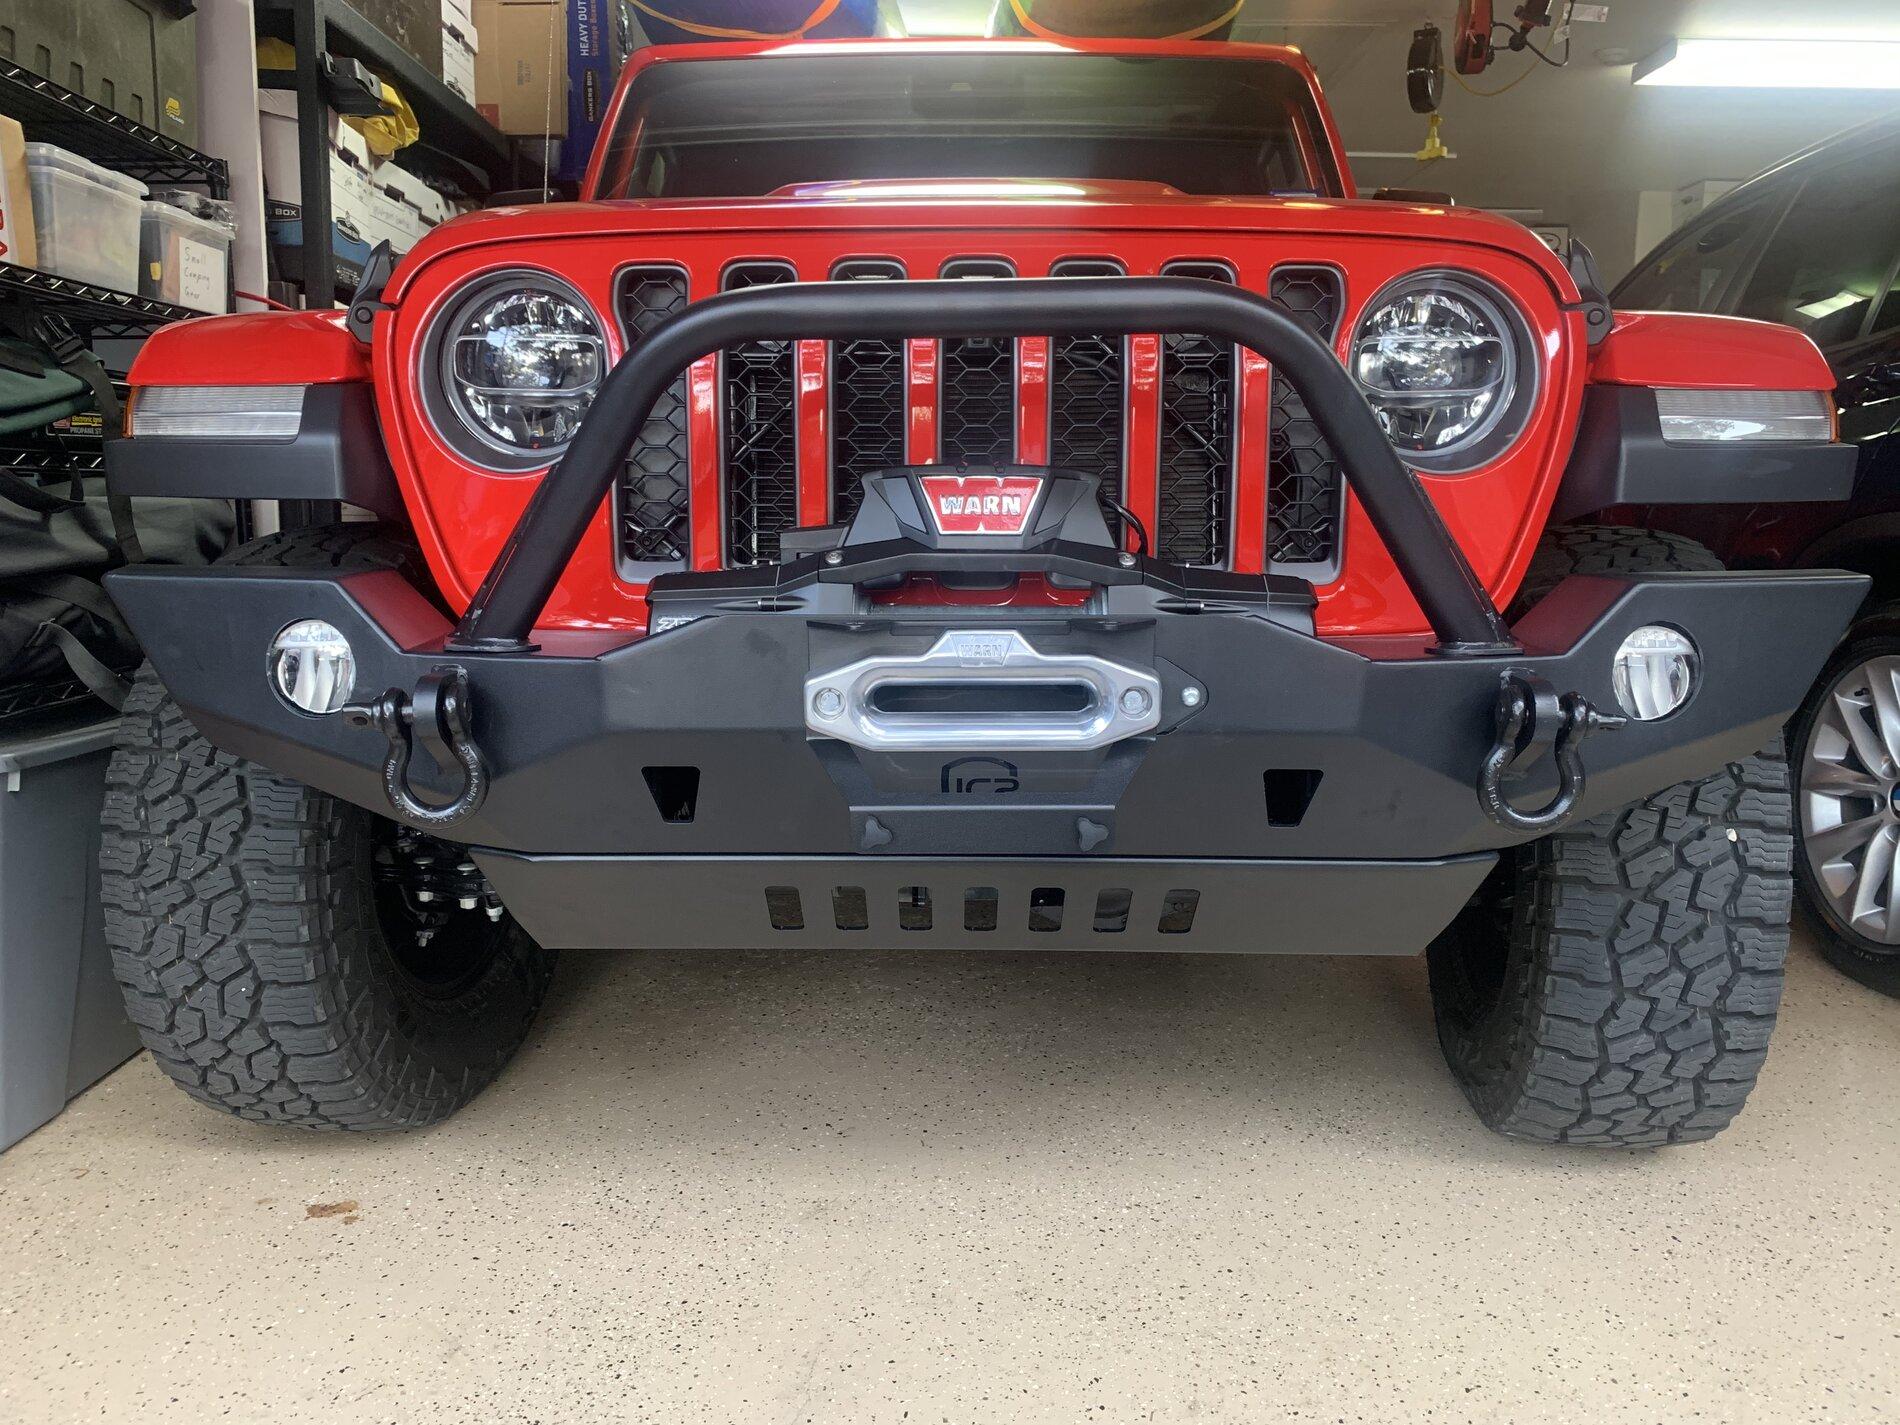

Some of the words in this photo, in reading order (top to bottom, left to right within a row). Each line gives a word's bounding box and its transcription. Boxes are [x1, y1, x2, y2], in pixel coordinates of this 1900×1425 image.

[577, 0, 588, 21] DUT
[578, 23, 589, 56] HEAVY
[275, 208, 297, 216] BOX
[70, 427, 94, 435] PROPANE
[940, 494, 1021, 515] WARN
[960, 644, 1002, 657] WARN
